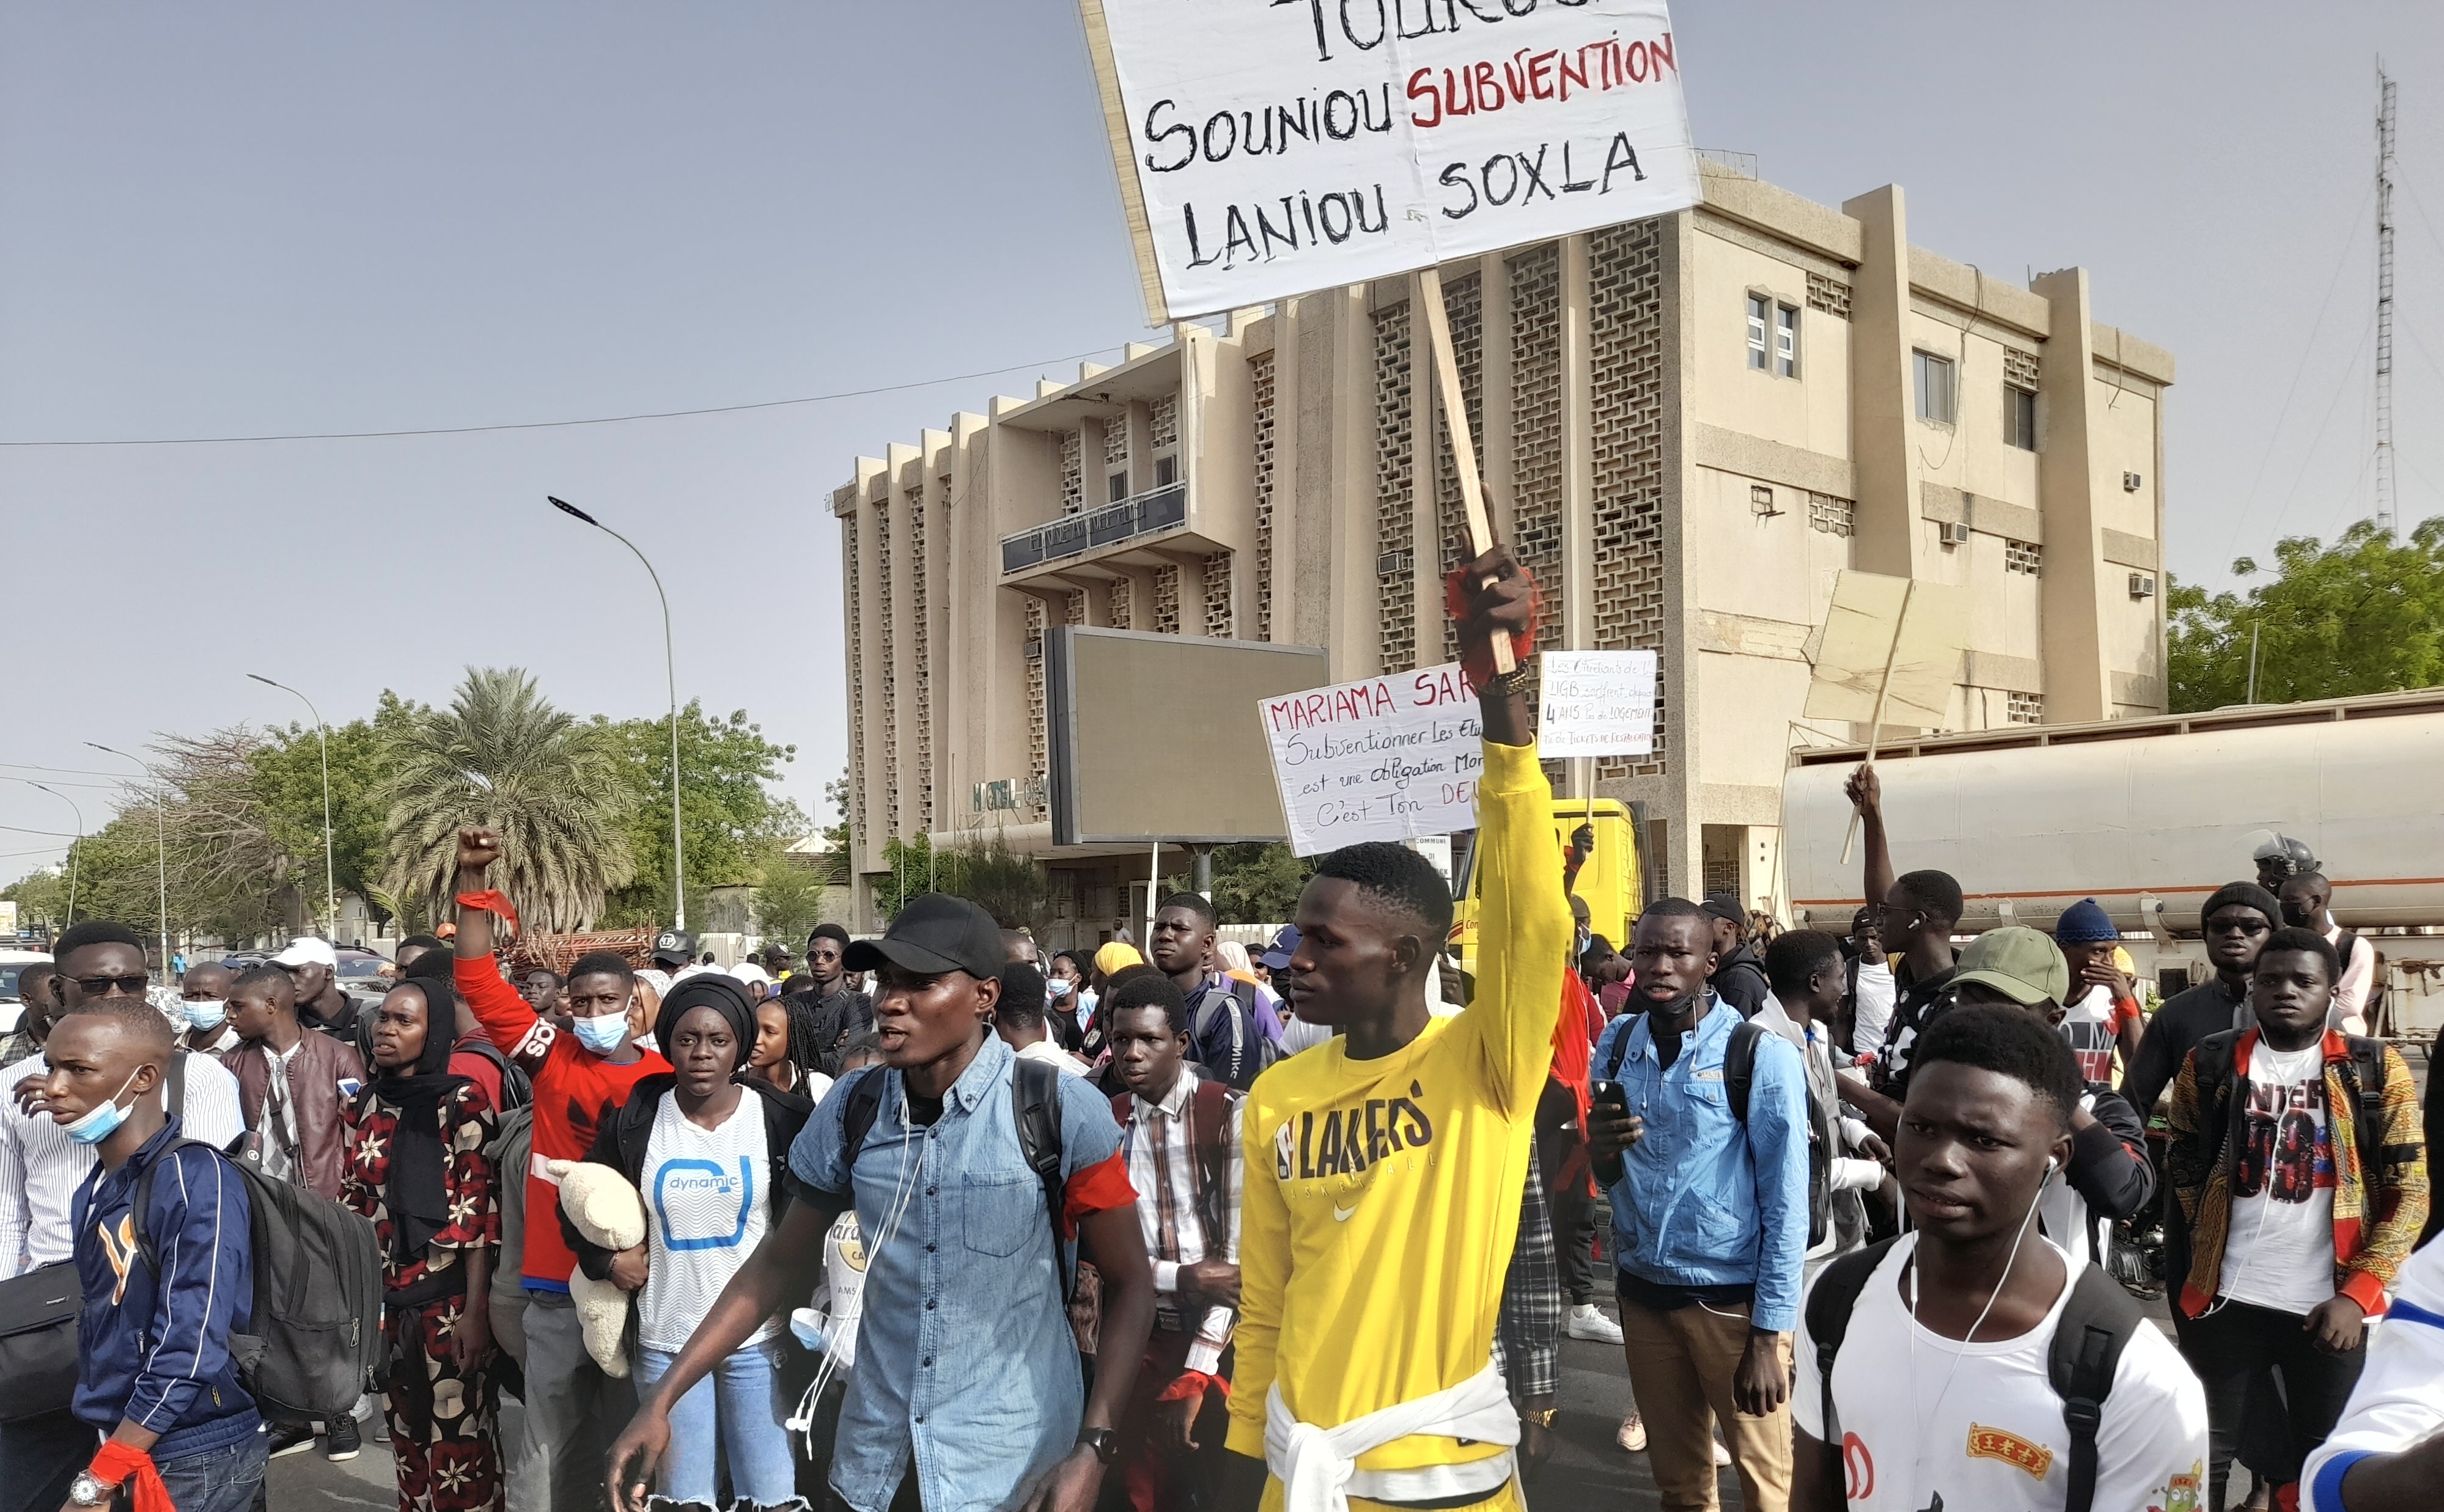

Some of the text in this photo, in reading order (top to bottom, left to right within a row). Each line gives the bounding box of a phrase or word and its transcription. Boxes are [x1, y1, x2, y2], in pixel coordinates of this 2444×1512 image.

[1438, 131, 1647, 219] SOXLA
[1624, 661, 1639, 673] de
[1550, 681, 1579, 699] UGB
[1271, 682, 1397, 732] MARIAMA
[1546, 703, 1555, 724] 4
[1597, 711, 1608, 721] de
[1286, 728, 1427, 766] Subventionner
[973, 777, 1021, 812] HOTEL
[1297, 773, 1330, 797] est
[1339, 772, 1364, 787] une
[1317, 799, 1373, 827] C'est
[1375, 791, 1425, 816] Ton
[1300, 1079, 1432, 1179] LAKERS
[669, 1175, 738, 1192] dynamic
[1982, 1434, 2034, 1464] 王老吉
